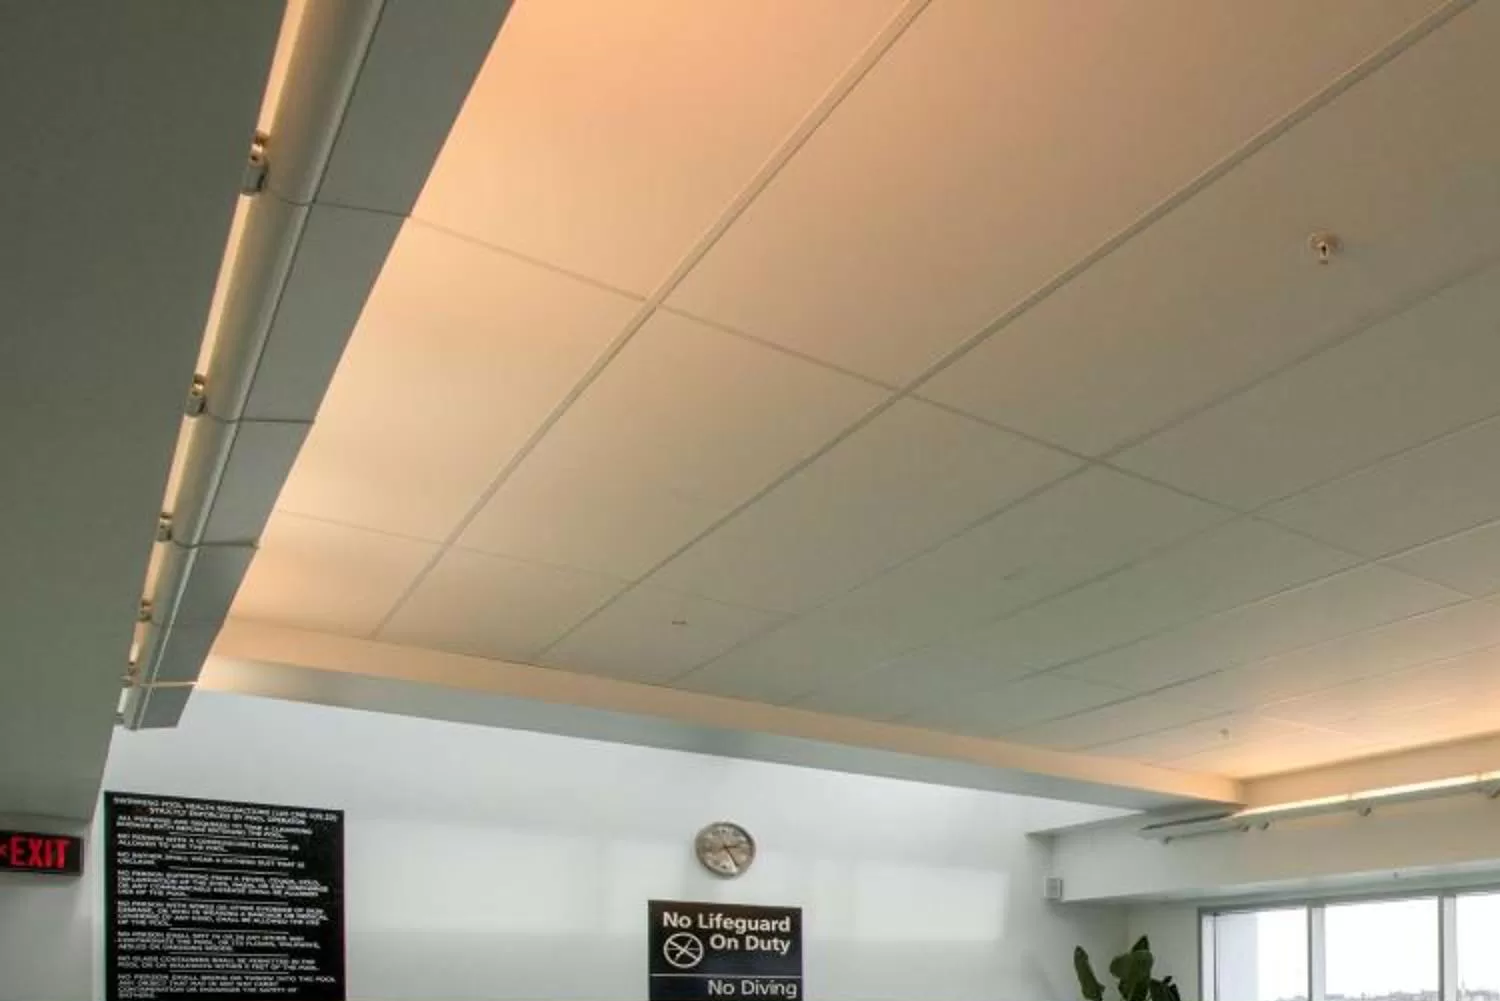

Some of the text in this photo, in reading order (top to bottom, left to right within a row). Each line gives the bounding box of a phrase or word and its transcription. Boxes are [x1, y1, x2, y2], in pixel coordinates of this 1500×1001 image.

[11, 836, 70, 868] EXIT
[662, 911, 791, 934] No Lifeguard
[709, 934, 791, 955] On Duty
[707, 980, 798, 999] No Diving
